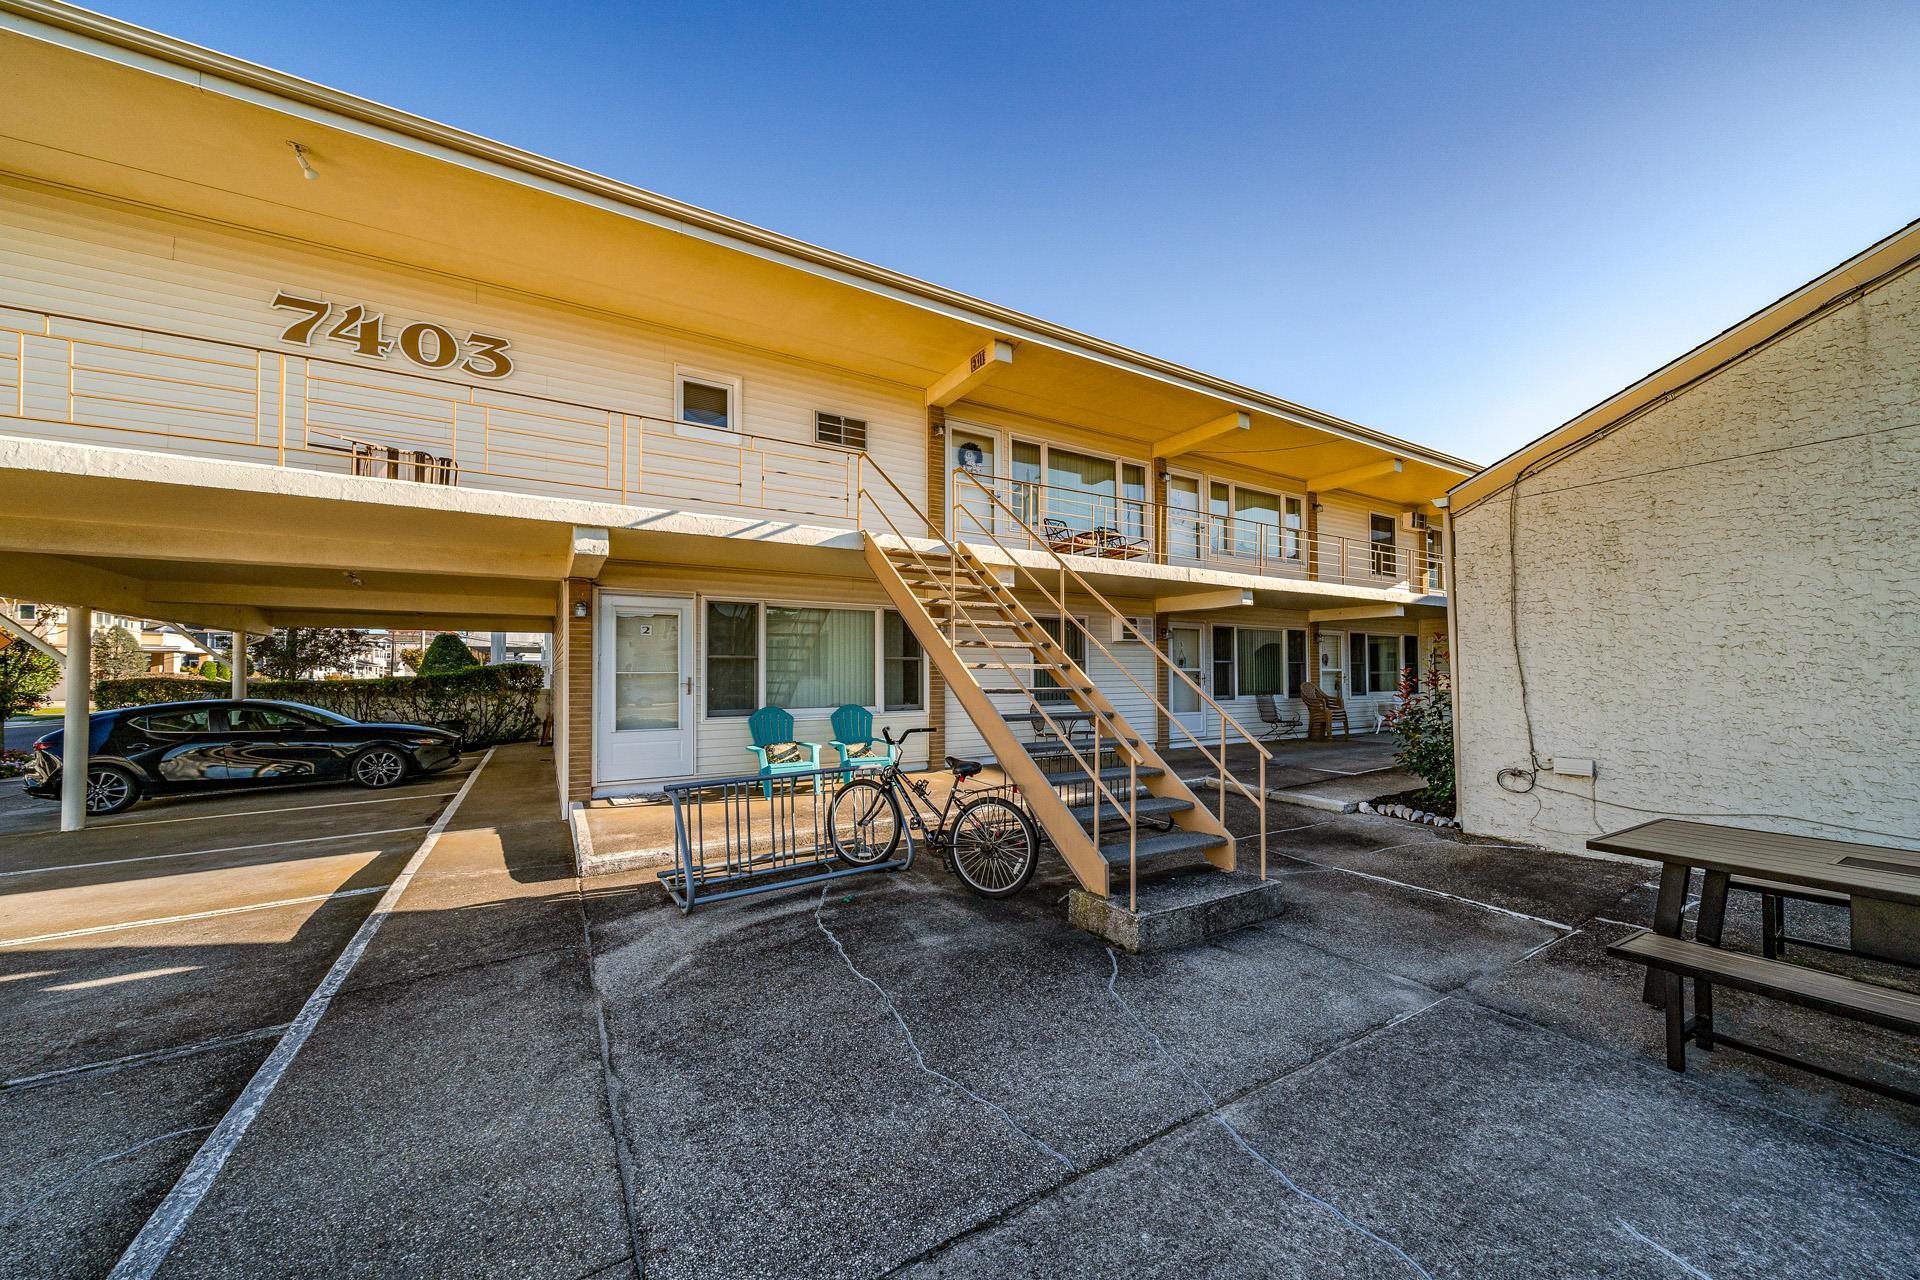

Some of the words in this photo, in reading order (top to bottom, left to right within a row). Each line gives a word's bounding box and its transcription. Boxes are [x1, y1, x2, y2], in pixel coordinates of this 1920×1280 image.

[270, 288, 515, 380] 7403
[971, 350, 985, 371] EXIT
[641, 625, 650, 635] 2
